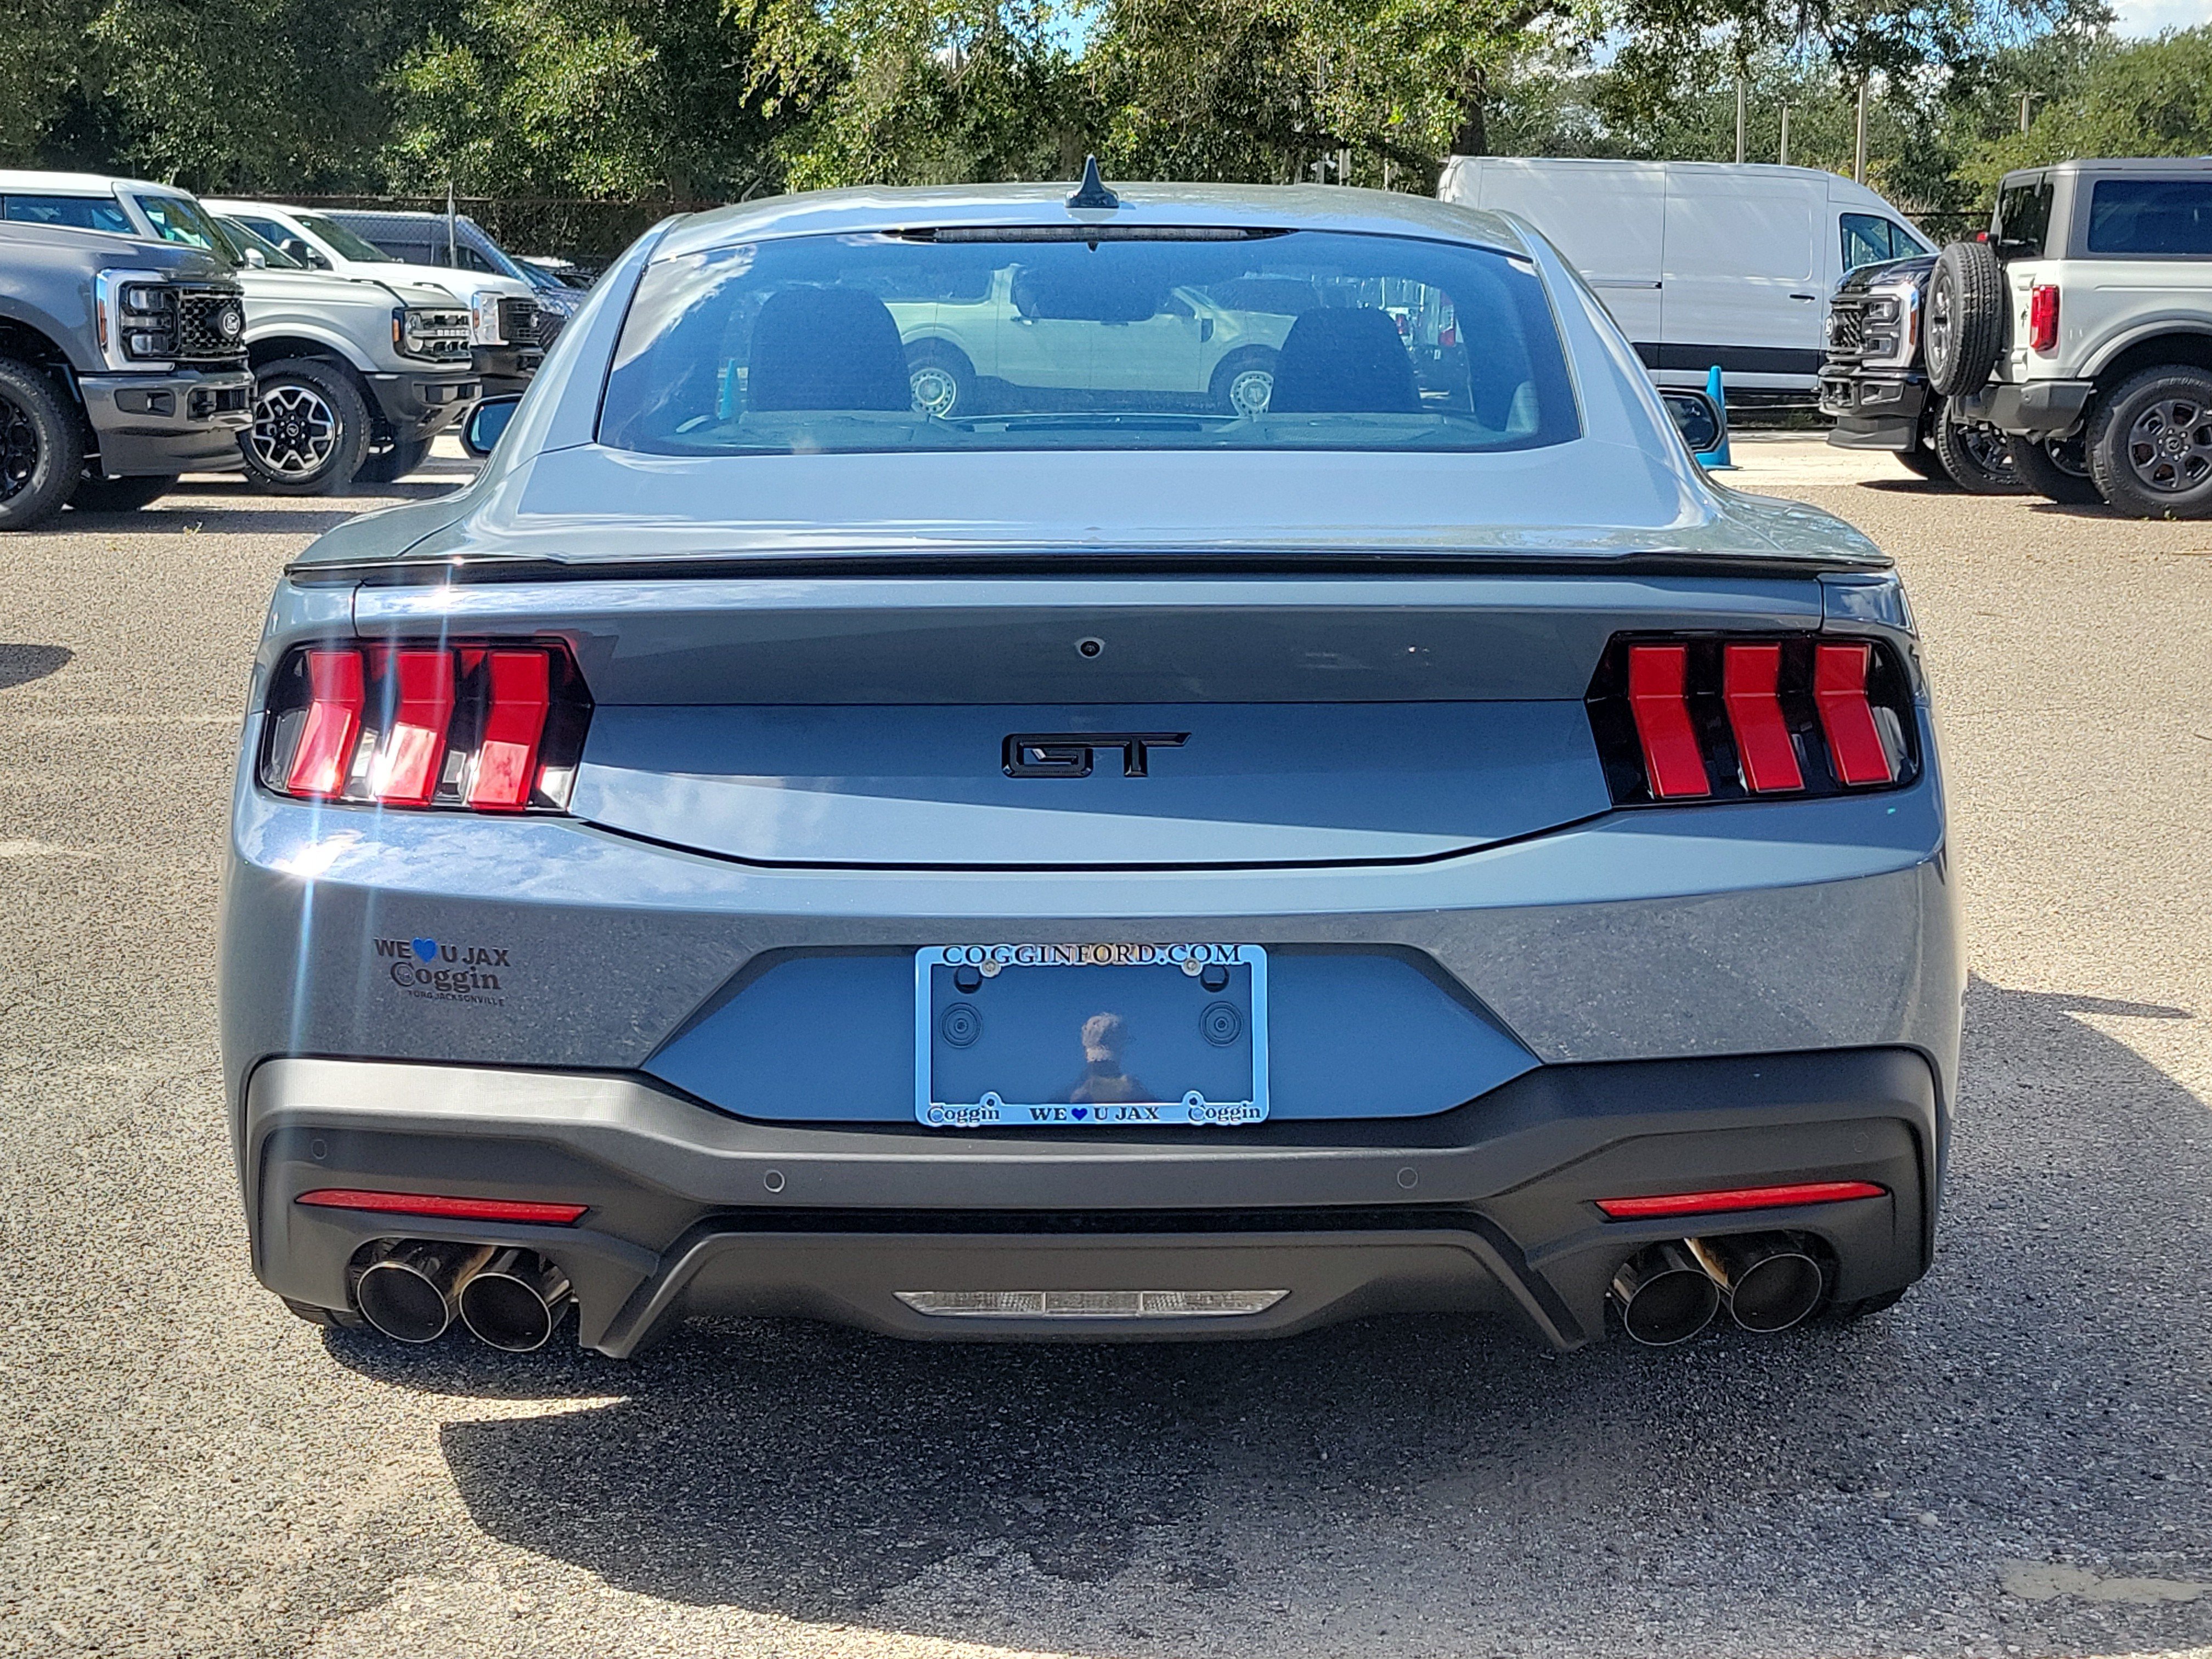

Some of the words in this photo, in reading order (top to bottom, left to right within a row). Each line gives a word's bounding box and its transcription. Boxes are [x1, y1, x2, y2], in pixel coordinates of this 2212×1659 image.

[1001, 732, 1192, 778] GT
[373, 937, 411, 960] WE
[440, 944, 458, 963] U
[462, 946, 511, 967] JAX
[942, 944, 1243, 964] COGGINFORD.COM
[390, 962, 502, 994] Coggin
[435, 992, 505, 1007] JACKSONVILLE
[927, 1105, 1000, 1124] Coggin
[1029, 1107, 1067, 1121] WE
[1093, 1107, 1109, 1121] U
[1115, 1107, 1161, 1121] JAX
[1188, 1103, 1261, 1122] Coggin
